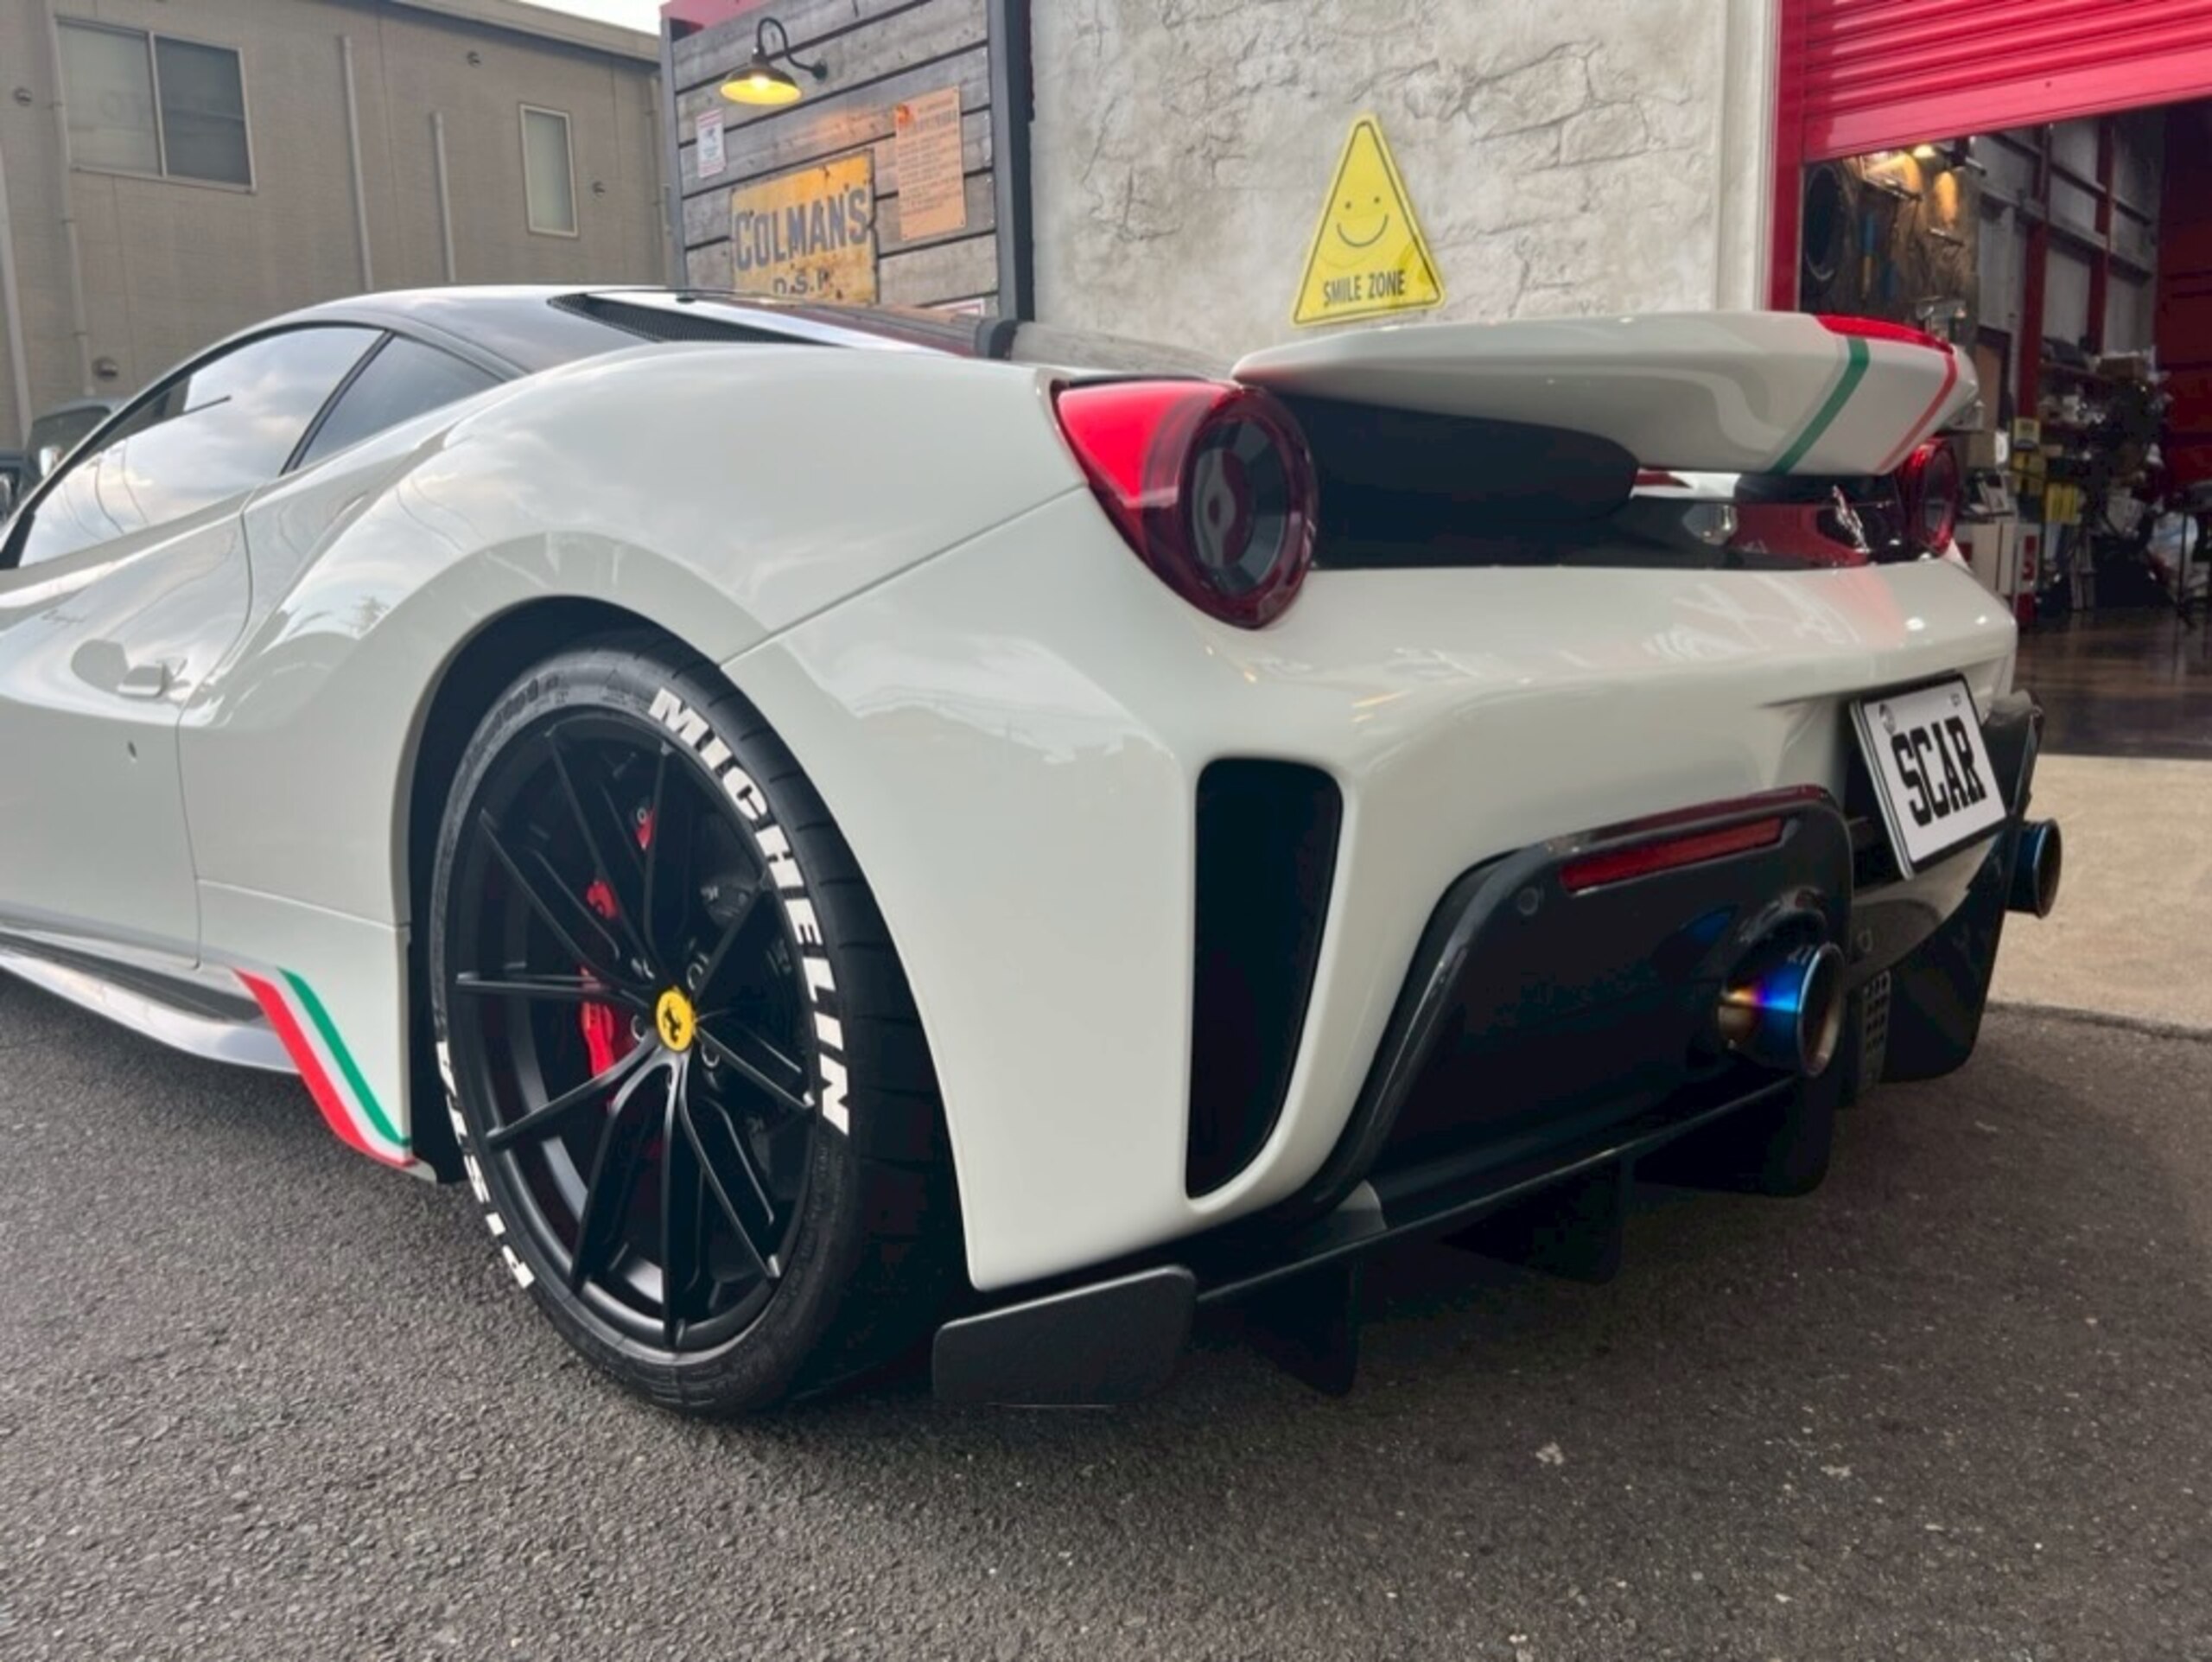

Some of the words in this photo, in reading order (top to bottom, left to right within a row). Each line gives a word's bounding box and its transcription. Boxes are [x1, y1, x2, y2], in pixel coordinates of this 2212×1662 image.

[1323, 274, 1362, 306] SMILE
[1368, 269, 1406, 299] ZONE
[1891, 715, 1987, 828] SCAR
[648, 687, 849, 1137] MICHELIN
